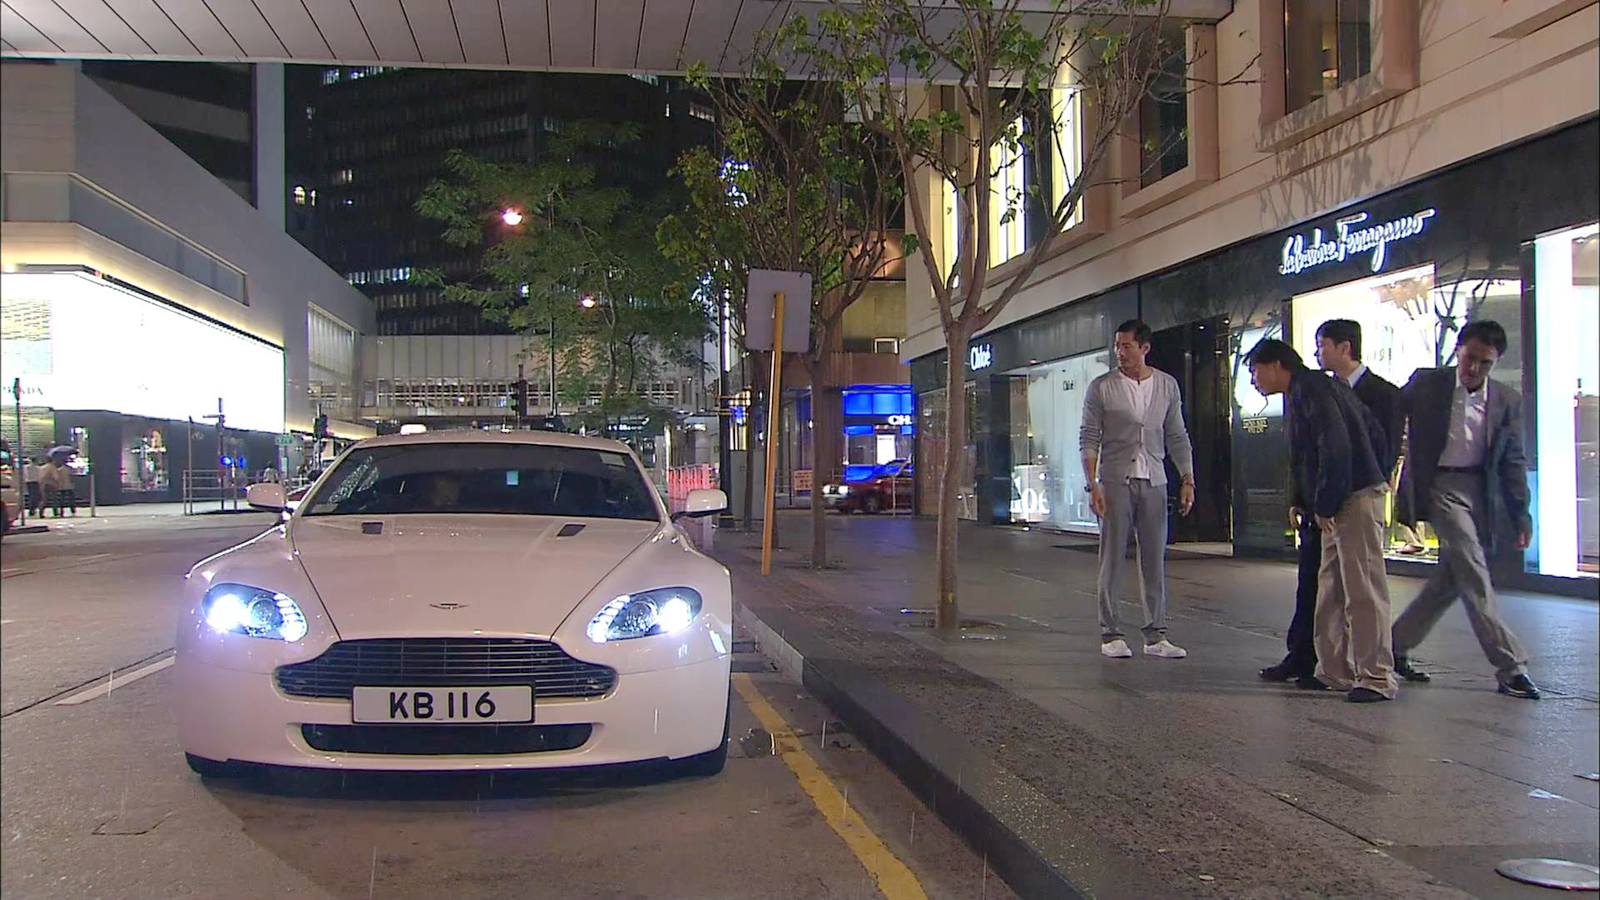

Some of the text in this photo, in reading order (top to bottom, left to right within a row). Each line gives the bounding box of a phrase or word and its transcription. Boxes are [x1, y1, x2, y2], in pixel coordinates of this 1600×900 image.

[1336, 208, 1436, 273] Ferragamo
[390, 691, 496, 719] KB 116
